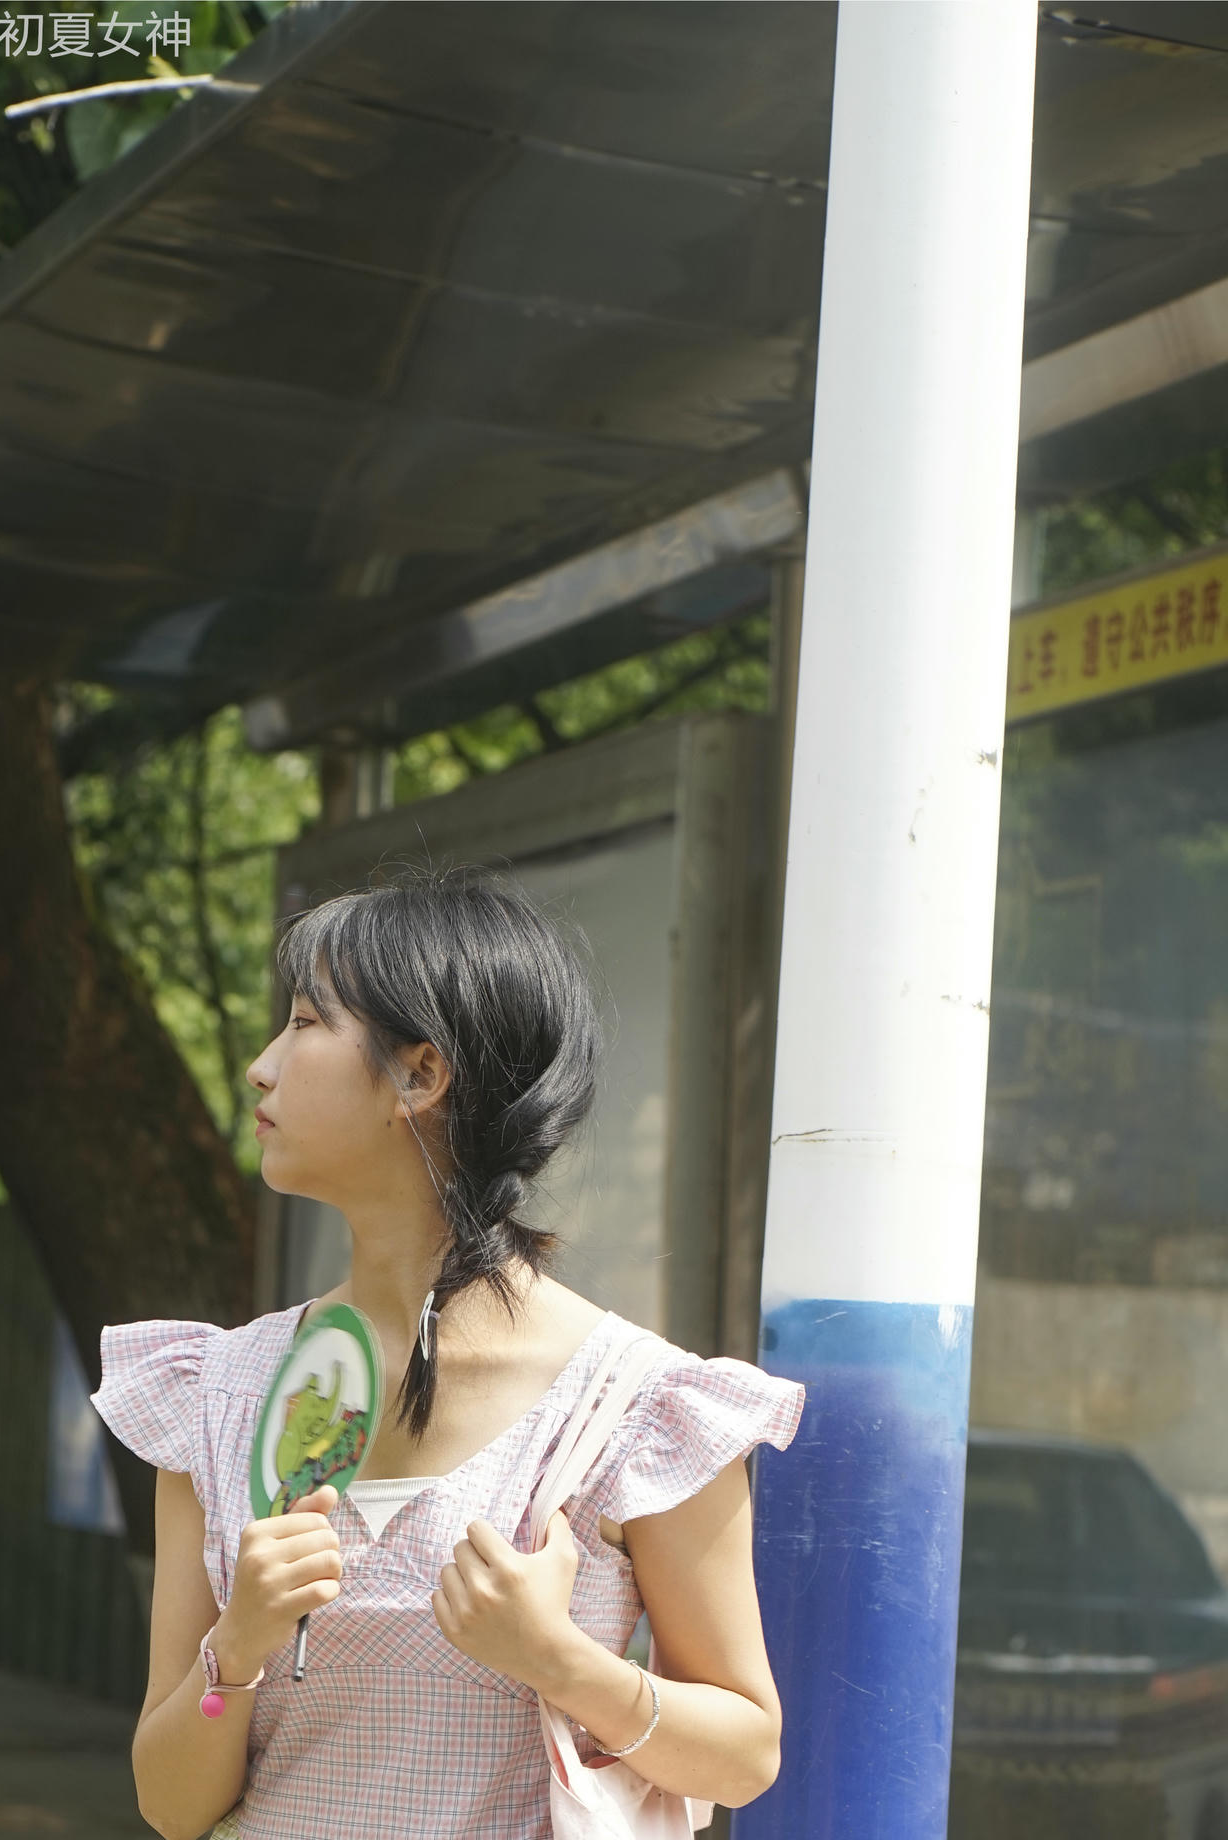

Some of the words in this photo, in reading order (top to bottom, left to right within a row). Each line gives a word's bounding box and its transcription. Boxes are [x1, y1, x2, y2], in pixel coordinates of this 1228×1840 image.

[1018, 576, 1228, 694] 上车，遵守公共秩序
